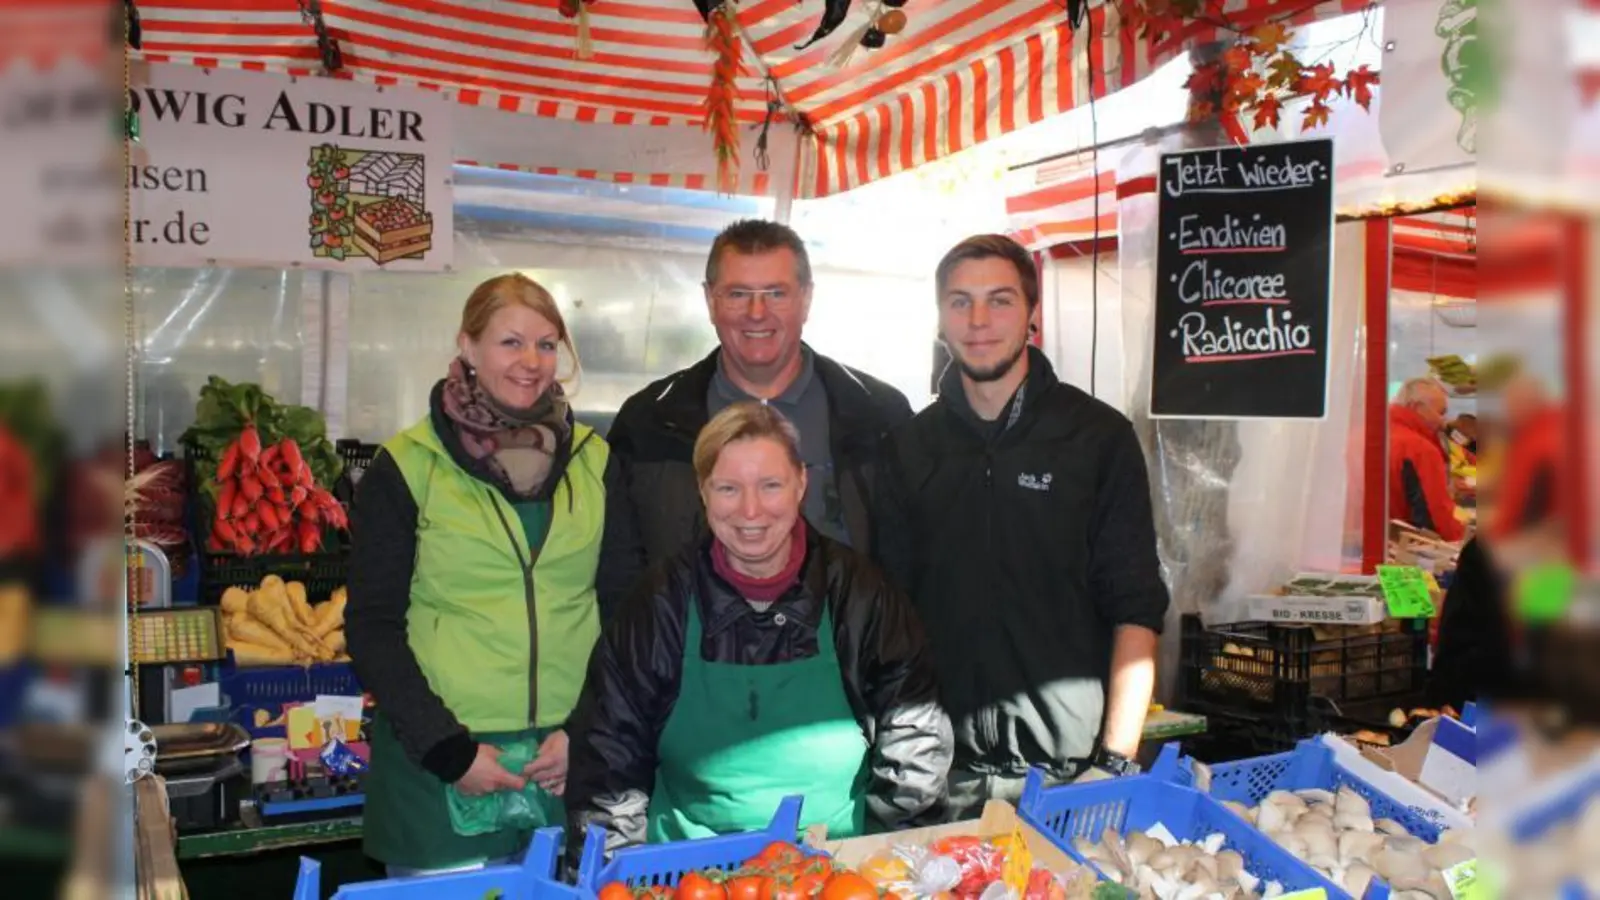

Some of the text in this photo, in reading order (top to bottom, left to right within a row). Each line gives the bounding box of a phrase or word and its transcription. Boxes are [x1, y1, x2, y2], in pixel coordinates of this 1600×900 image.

[262, 90, 425, 142] ADLER
[1165, 151, 1228, 196] Jetzt
[1272, 609, 1291, 618] BIO
[1300, 610, 1343, 620] KRESSE
